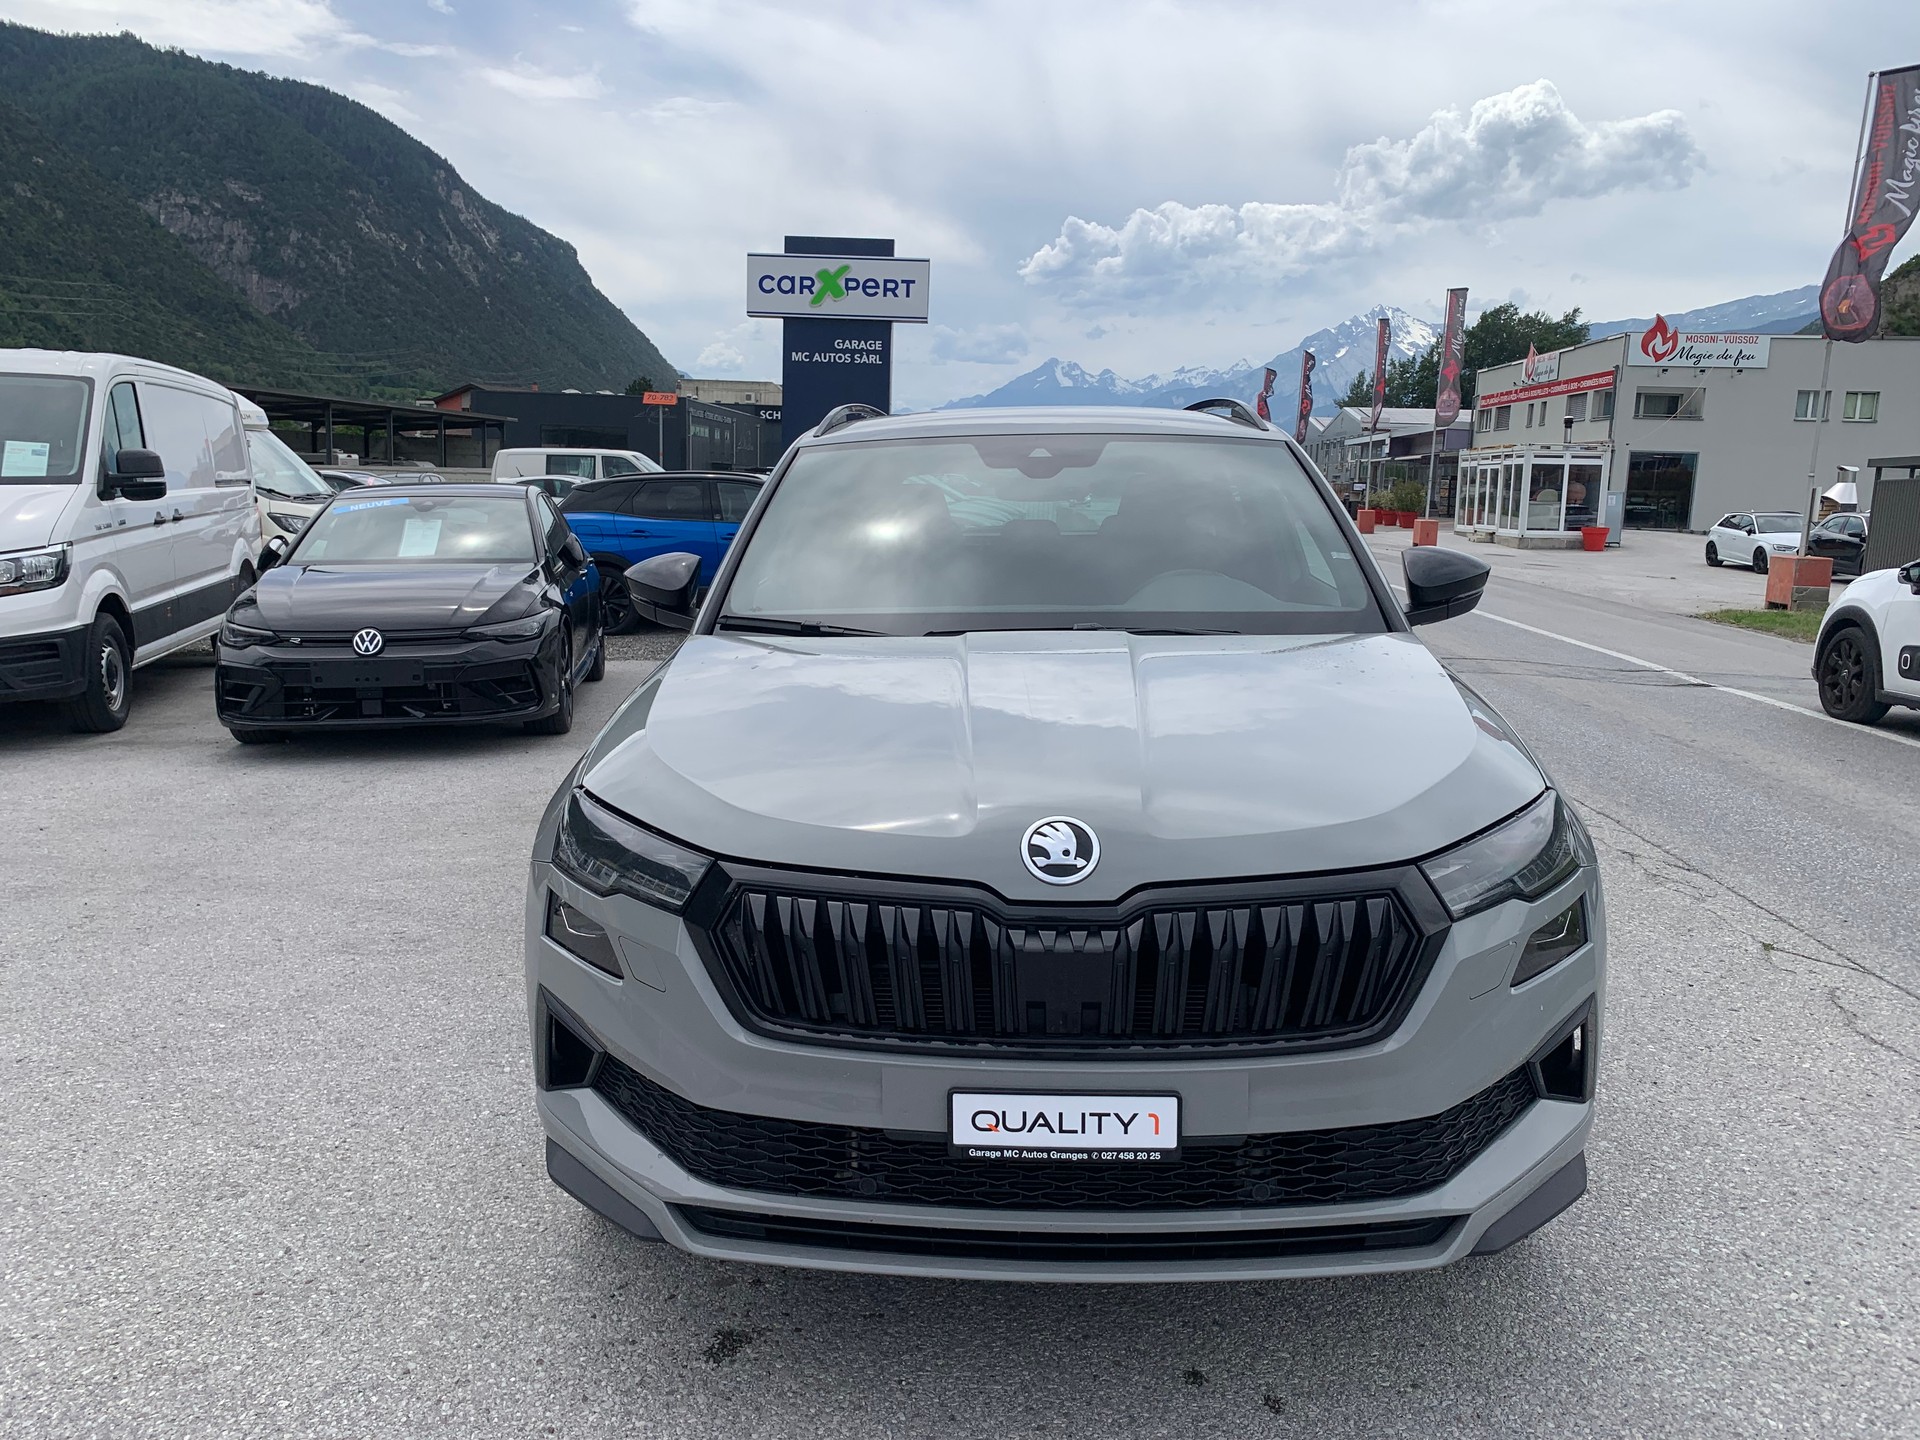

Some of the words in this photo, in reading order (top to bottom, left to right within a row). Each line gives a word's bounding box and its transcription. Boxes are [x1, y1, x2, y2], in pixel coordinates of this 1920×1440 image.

[834, 339, 882, 350] GARAGE
[1685, 334, 1759, 345] MOSONI-VUISSOZ
[791, 351, 810, 362] MC
[812, 352, 852, 363] AUTOS
[1668, 345, 1714, 366] Magie
[1716, 348, 1734, 361] du
[1733, 348, 1756, 367] feu
[350, 499, 391, 511] NEUVE
[971, 1109, 1139, 1135] QUALITY
[968, 1148, 1001, 1159] Garage
[1003, 1149, 1019, 1158] MC
[1021, 1150, 1048, 1159] Autos
[1050, 1151, 1088, 1161] Granges
[1101, 1151, 1116, 1160] 027
[1118, 1152, 1135, 1160] 458
[1136, 1152, 1148, 1160] 20
[1149, 1152, 1161, 1160] 25
